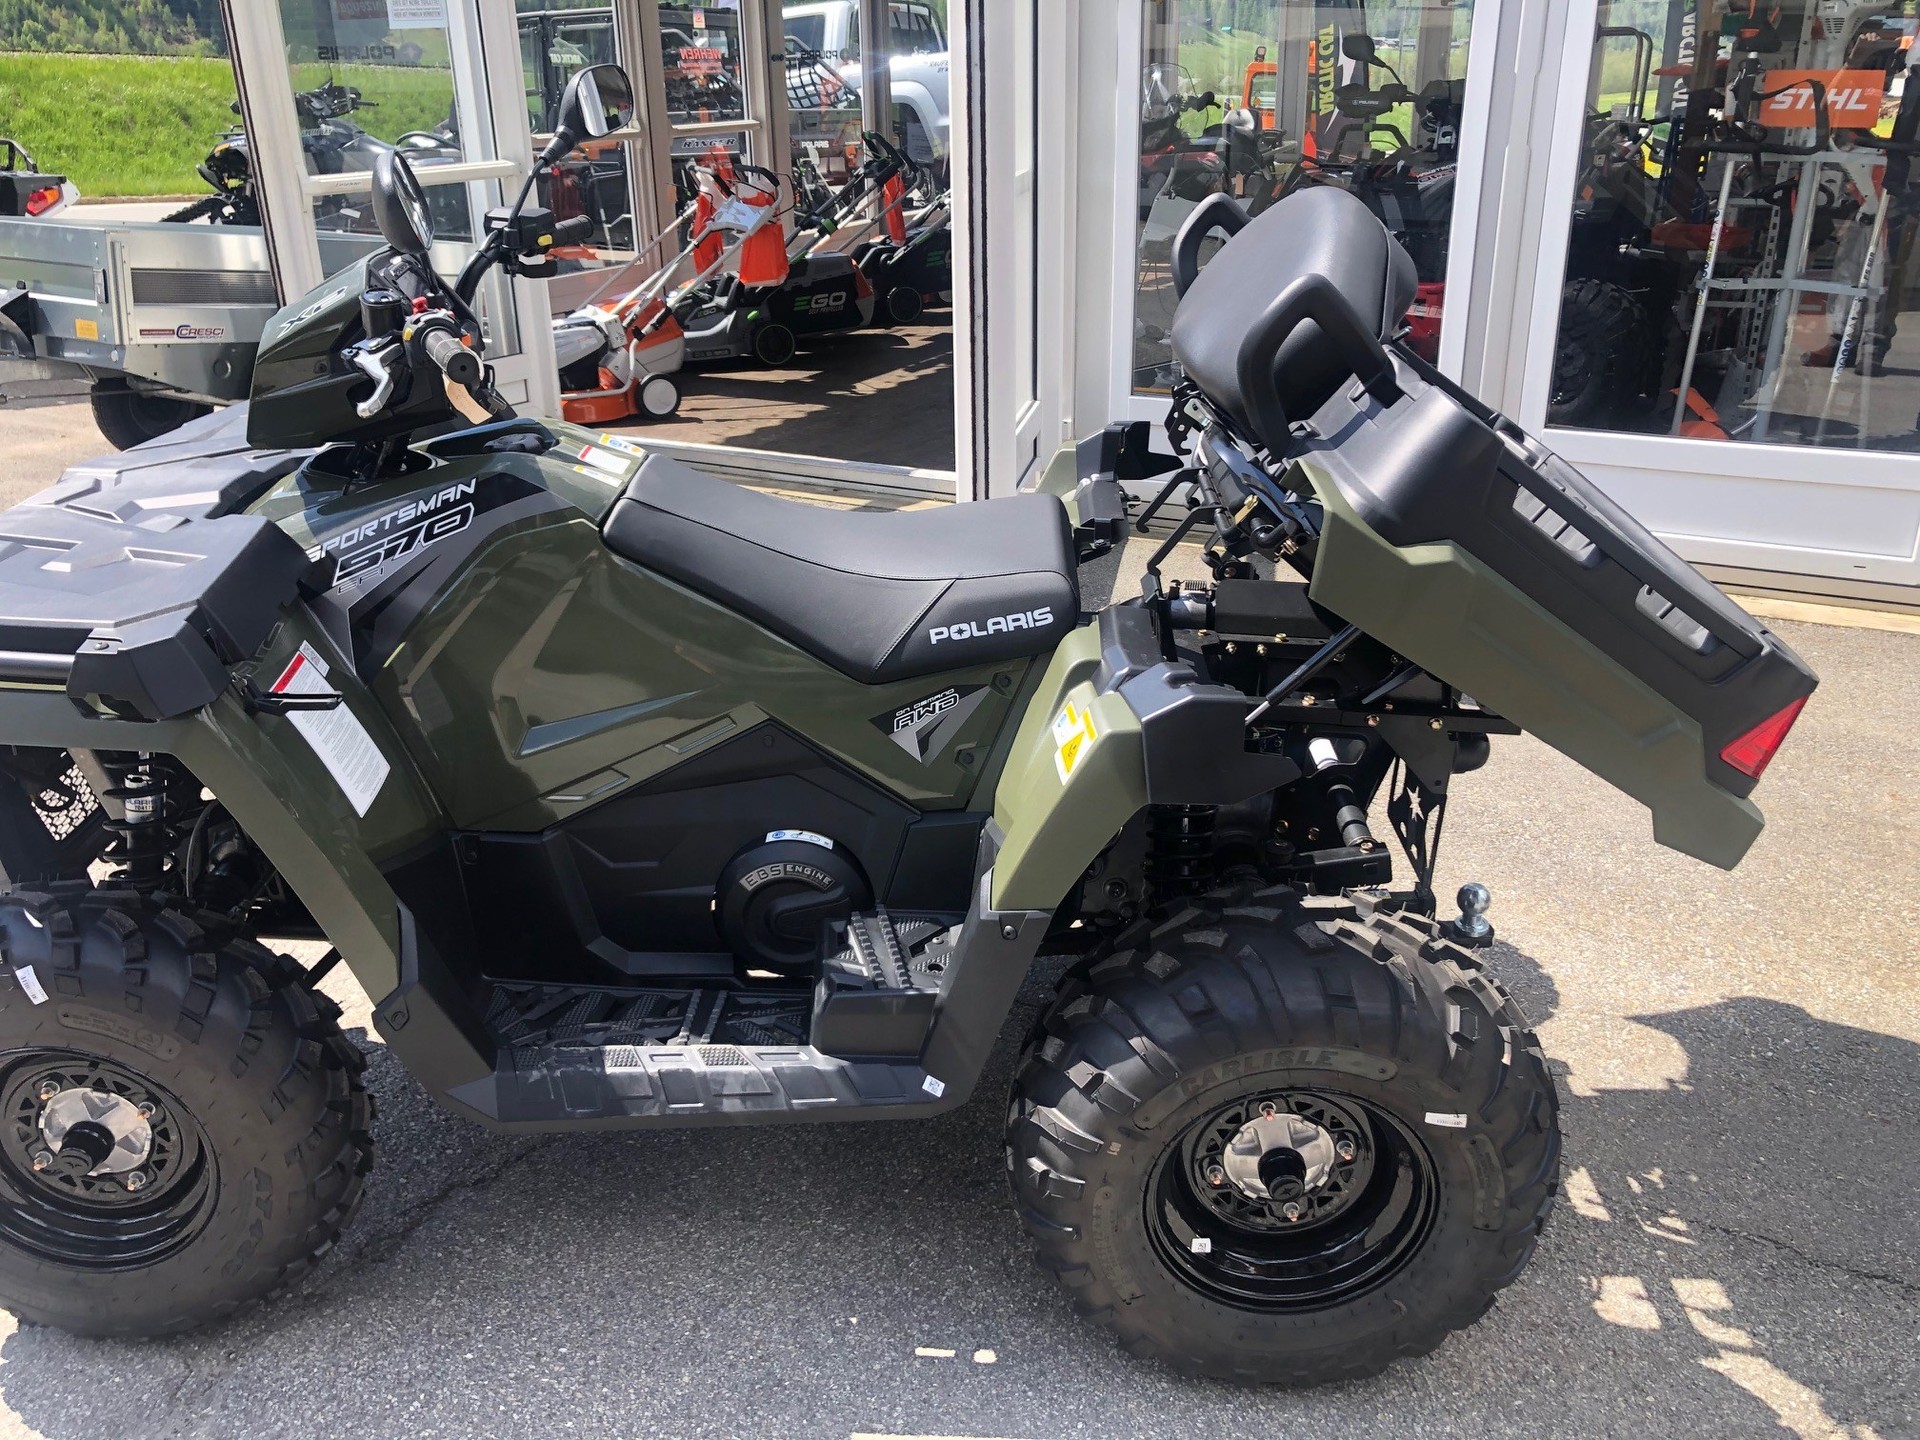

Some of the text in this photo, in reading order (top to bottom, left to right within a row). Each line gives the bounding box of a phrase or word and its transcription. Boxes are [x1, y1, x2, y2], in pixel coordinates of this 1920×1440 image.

[1769, 88, 1869, 110] STHL
[801, 140, 830, 148] POLARIS
[793, 291, 847, 311] EGO
[178, 326, 224, 337] CRESCI
[304, 477, 477, 563] SPORTSMAN
[332, 502, 475, 587] 570
[929, 606, 1054, 645] POLARIS
[894, 693, 959, 732] AWD
[896, 688, 955, 717] ON DEMAND
[745, 864, 782, 887] EBS
[786, 864, 833, 886] ENGINE
[1179, 1050, 1340, 1098] CARLISLE
